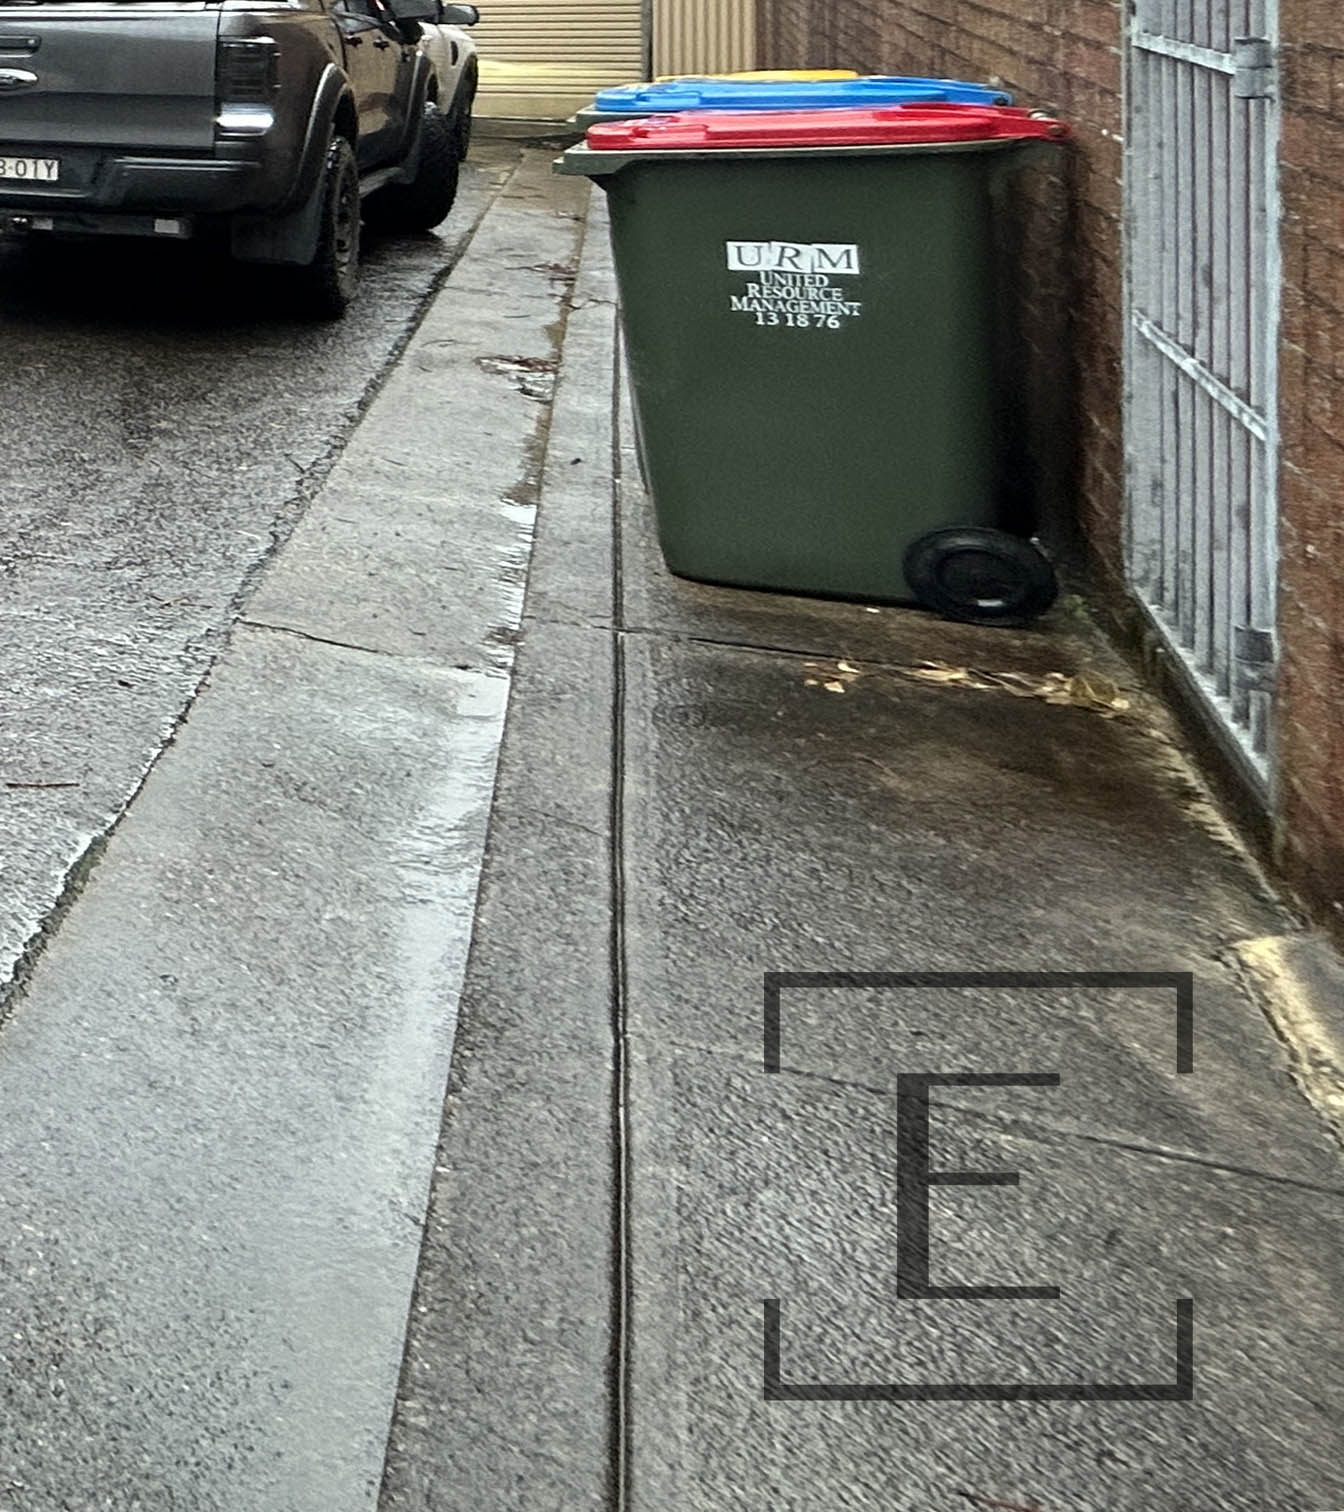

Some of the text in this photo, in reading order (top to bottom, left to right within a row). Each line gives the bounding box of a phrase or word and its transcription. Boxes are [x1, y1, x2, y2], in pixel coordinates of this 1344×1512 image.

[734, 245, 854, 270] URM
[760, 271, 829, 288] UNITED
[746, 282, 843, 301] RESOURCE
[729, 295, 862, 316] MANAGEMENT
[755, 312, 840, 329] 13 18 76
